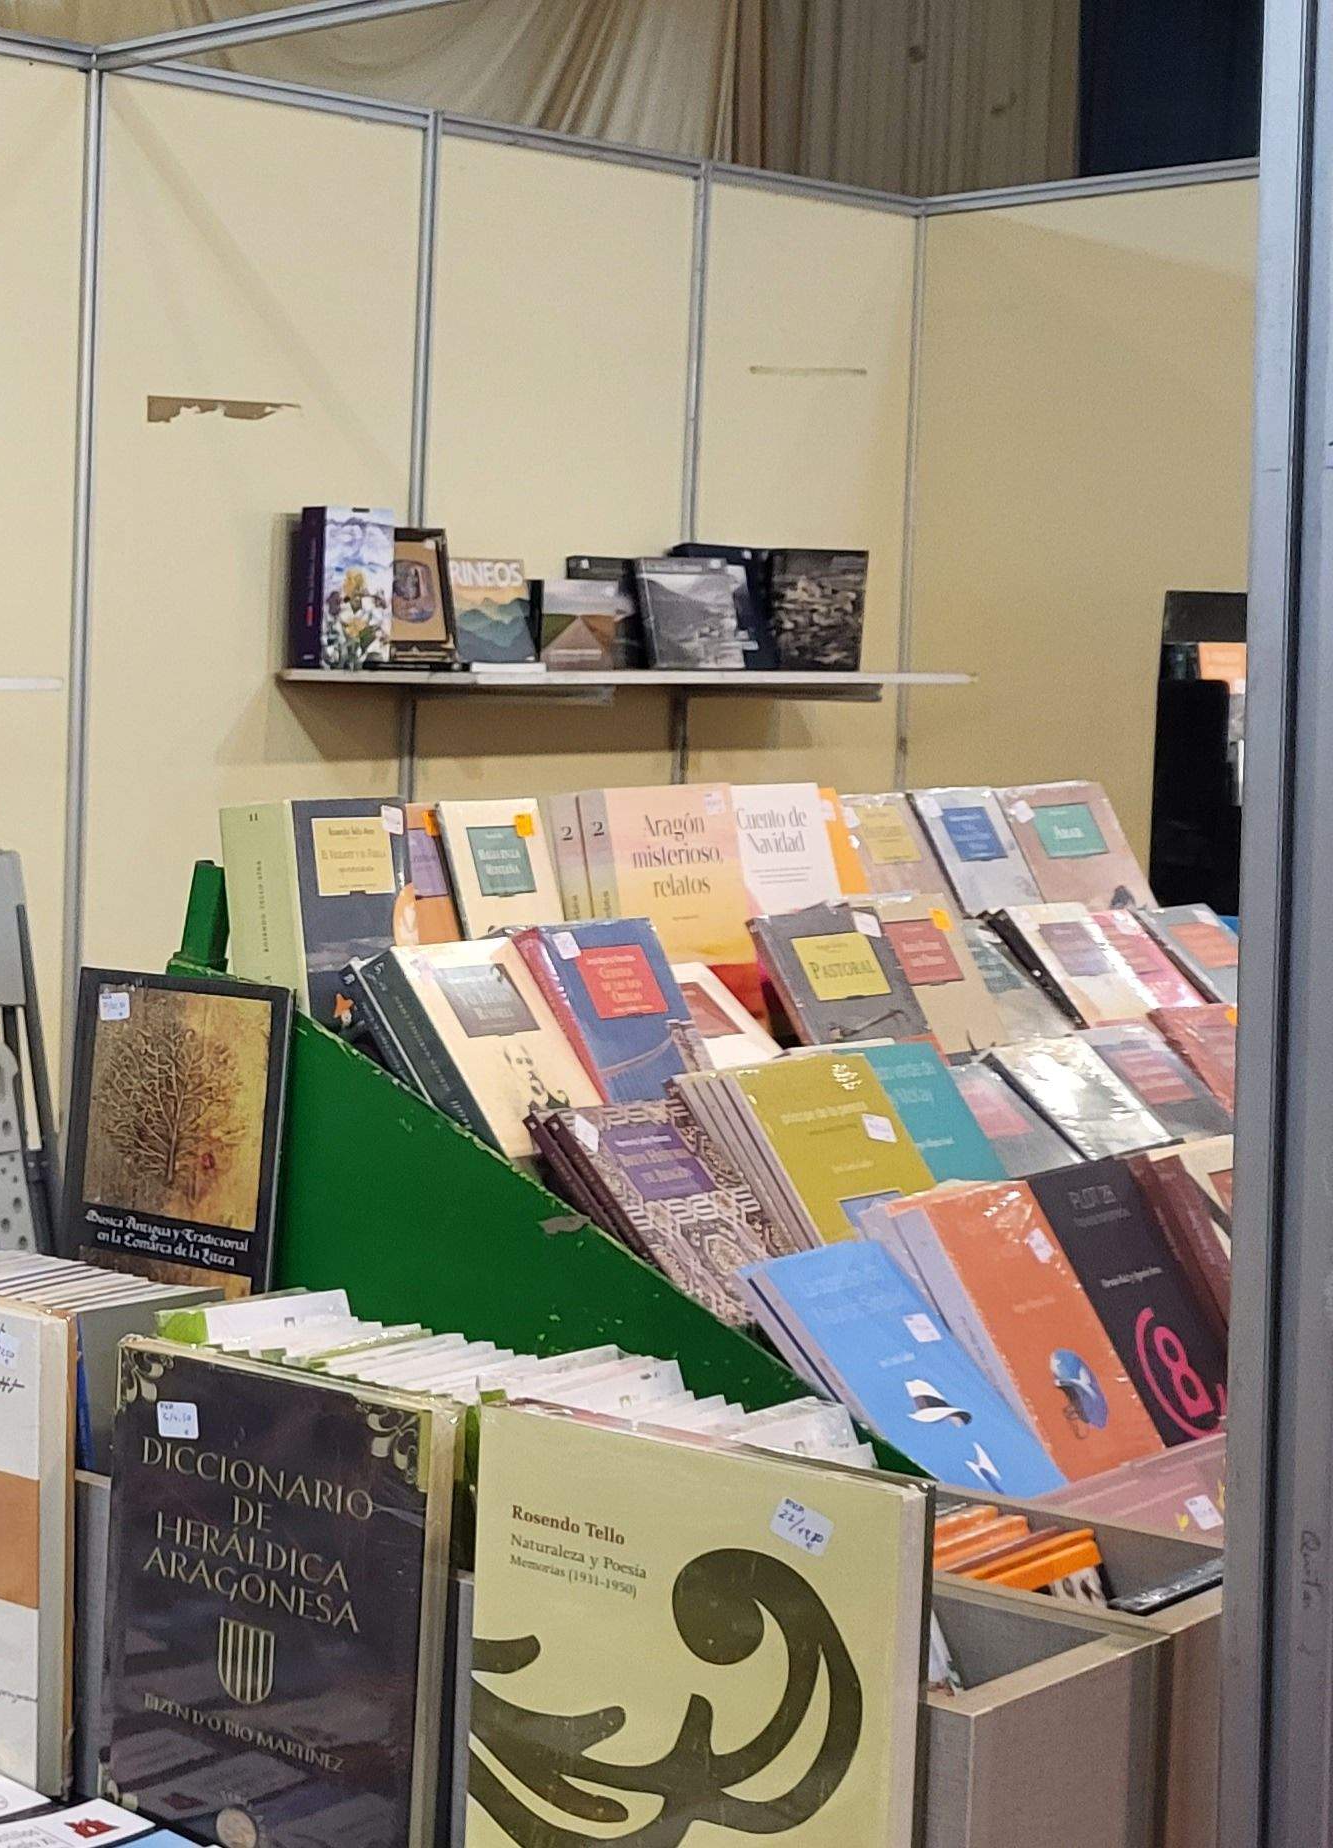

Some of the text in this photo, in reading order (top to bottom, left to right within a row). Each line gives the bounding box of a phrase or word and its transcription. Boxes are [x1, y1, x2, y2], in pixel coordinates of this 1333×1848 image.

[450, 560, 524, 588] RINEOS
[593, 821, 605, 837] 2
[643, 812, 705, 842] Aragón
[736, 805, 808, 831] Cuento de
[561, 826, 574, 841] 2
[747, 830, 806, 855] Navidad
[633, 843, 724, 870] misterioso,
[653, 872, 712, 899] relatos
[808, 960, 876, 980] PASTORAL
[174, 1243, 188, 1258] de
[188, 1243, 200, 1260] la
[182, 1228, 250, 1253] Tradicional
[141, 1435, 375, 1521] DICCIONARIO
[232, 1494, 274, 1533] DE
[511, 1504, 626, 1546] Rosendo Tello
[155, 1511, 350, 1593] HERÁLDICA
[510, 1533, 648, 1580] Naturaleza y Poesía
[143, 1546, 361, 1635] ARAGONESA
[509, 1554, 638, 1601] Memorias (1931-1950)
